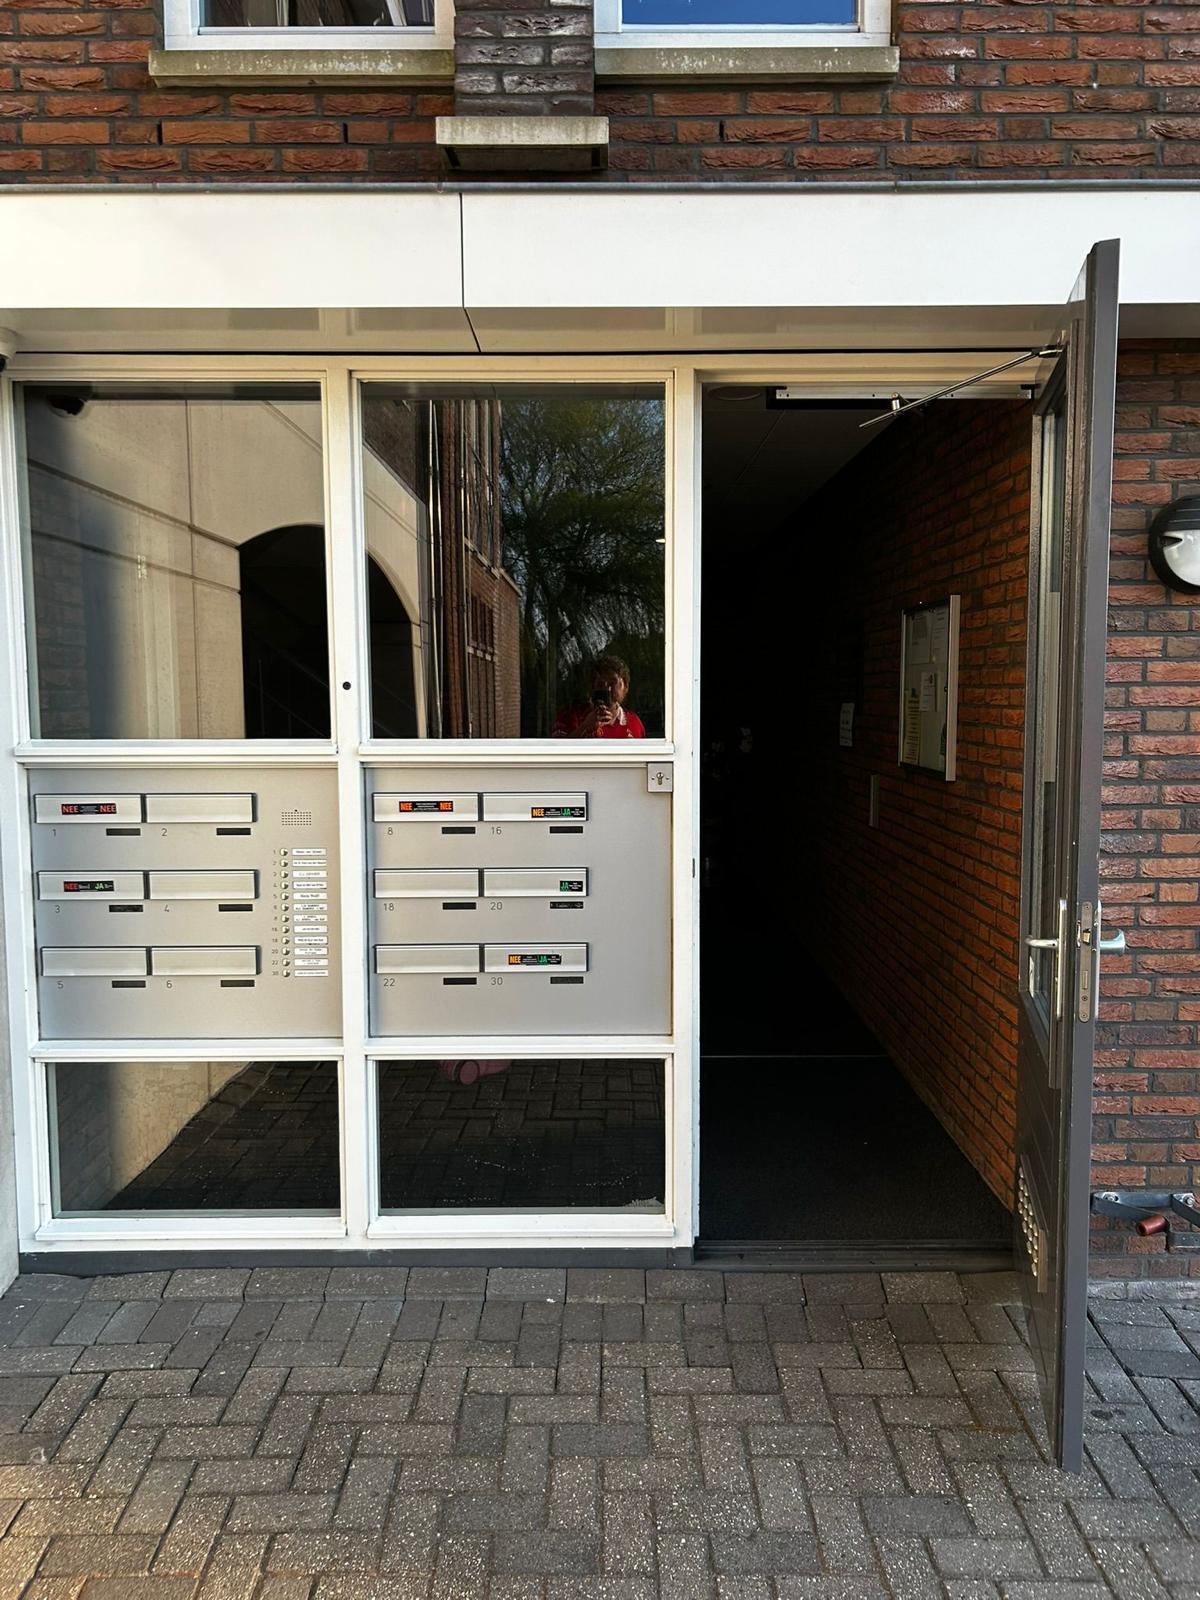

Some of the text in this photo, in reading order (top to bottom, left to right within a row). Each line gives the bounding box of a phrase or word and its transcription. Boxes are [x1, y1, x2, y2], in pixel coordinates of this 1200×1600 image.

[62, 805, 78, 813] NEE
[99, 805, 116, 813] NEE
[400, 802, 412, 811] NEE
[532, 808, 544, 817] NEE
[562, 808, 571, 817] JA
[51, 829, 56, 837] 1
[162, 828, 167, 837] 2
[387, 827, 394, 836] 8
[491, 826, 502, 835] 16
[94, 882, 104, 890] JA
[55, 904, 60, 913] 3
[164, 904, 170, 913] 4
[383, 902, 394, 911] 18
[490, 902, 503, 911] 20
[509, 955, 521, 964] NEE
[538, 955, 548, 964] JA
[57, 980, 63, 989] 5
[166, 980, 172, 988] 6
[383, 978, 395, 987] 22
[490, 977, 503, 986] 30
